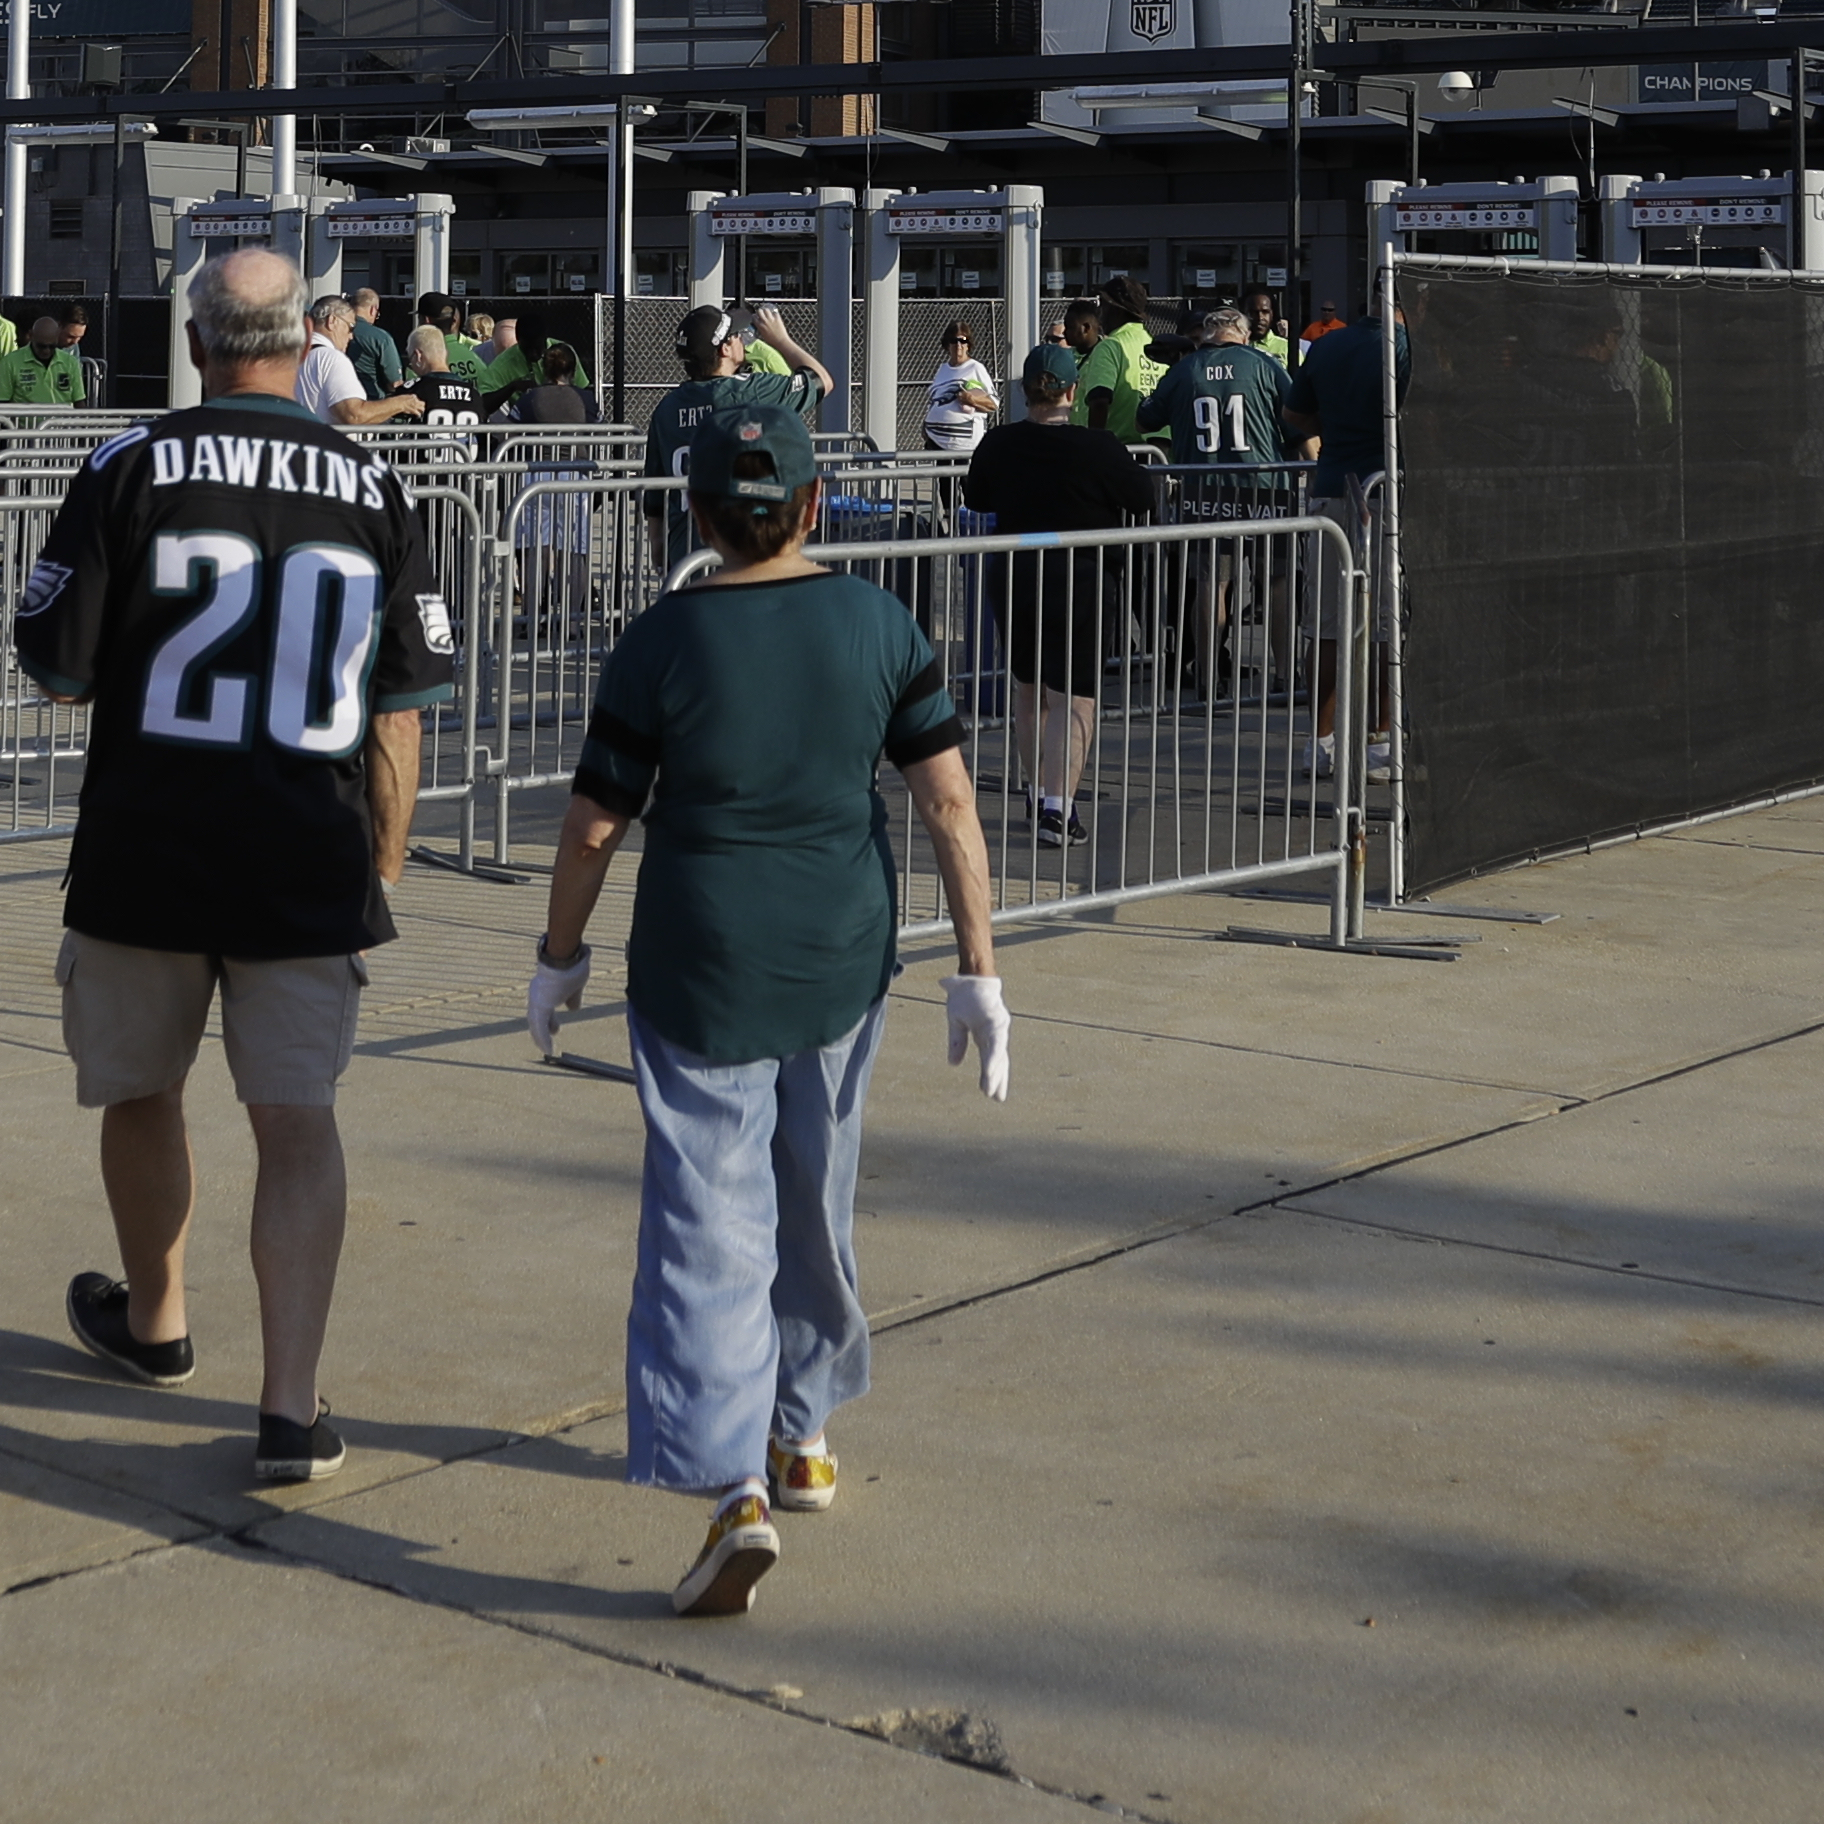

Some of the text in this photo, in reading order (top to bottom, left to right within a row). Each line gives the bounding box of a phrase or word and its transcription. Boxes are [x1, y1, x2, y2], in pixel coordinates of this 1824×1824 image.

[1133, 4, 1170, 35] NFL
[1644, 76, 1753, 91] CHAMPIONS
[1206, 364, 1234, 380] COX
[438, 385, 472, 402] ERTZ
[1193, 394, 1251, 453] 91
[151, 434, 385, 511] DAWKINS
[1183, 500, 1287, 519] PLEASE WAIT
[142, 532, 381, 755] 20
